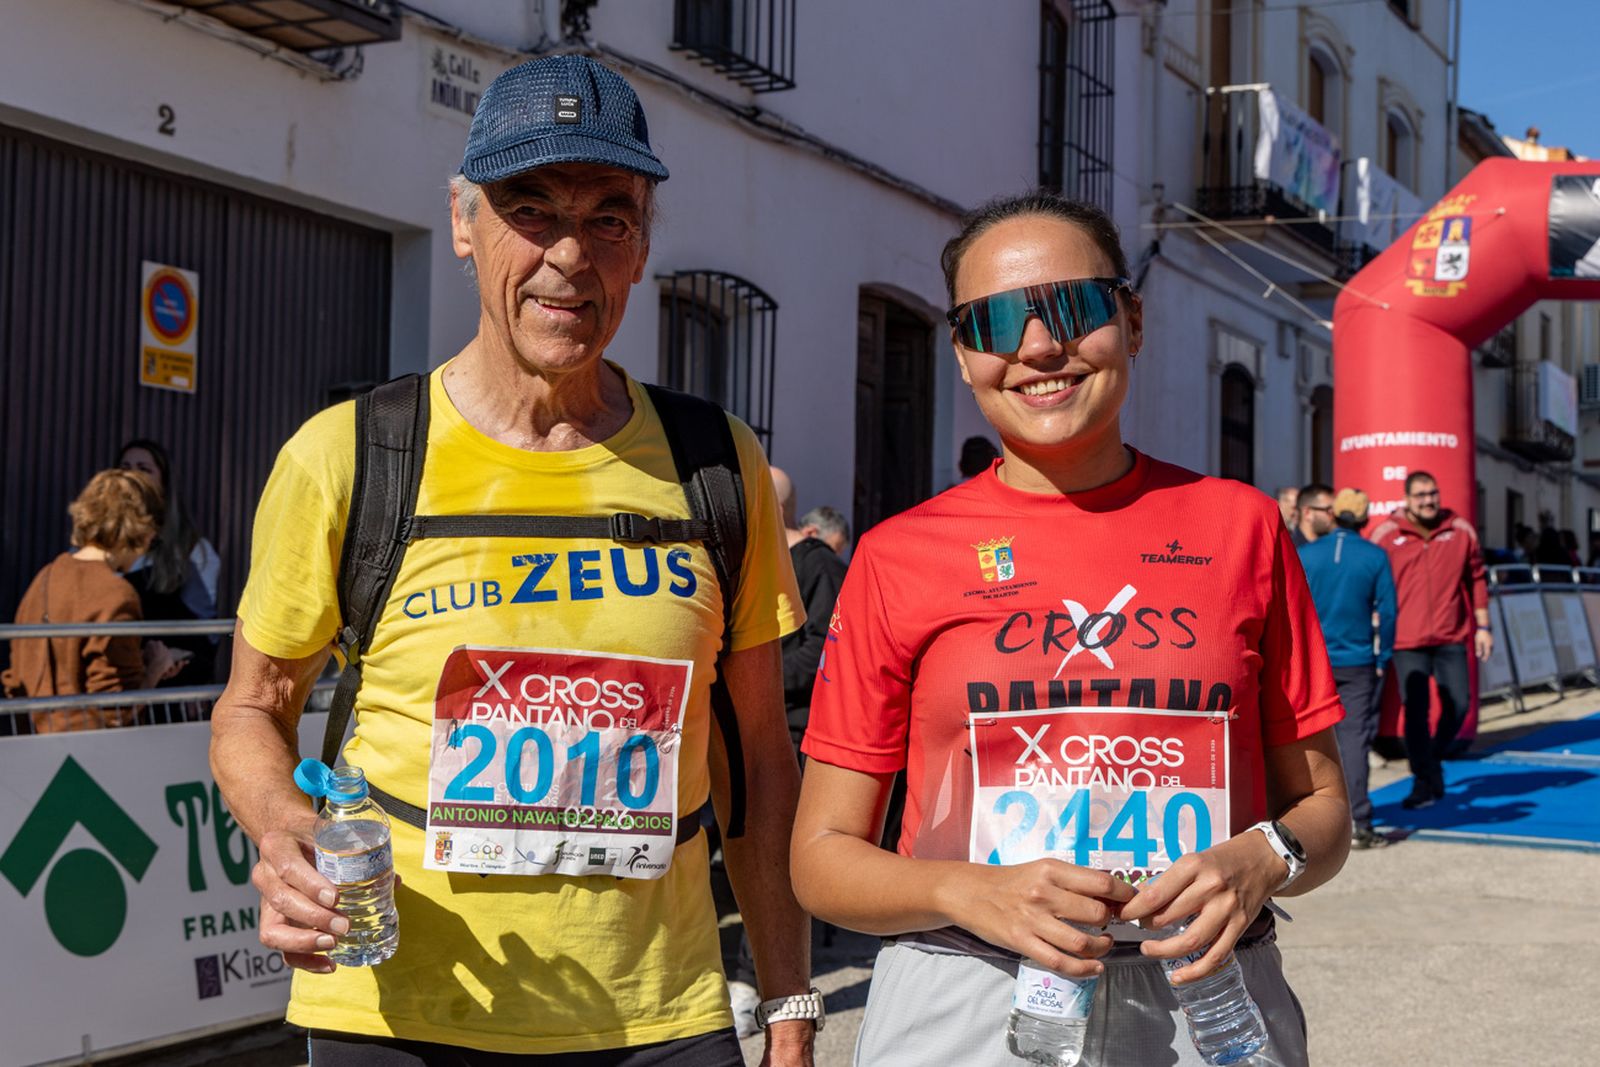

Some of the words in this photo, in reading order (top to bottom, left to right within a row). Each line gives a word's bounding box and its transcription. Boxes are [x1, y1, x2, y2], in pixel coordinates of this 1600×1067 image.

[157, 104, 176, 136] 2
[1340, 431, 1458, 452] AYUNTAMIENTO
[1382, 466, 1407, 480] DE
[1140, 552, 1213, 566] TEAMERGY
[402, 581, 503, 619] CLUB
[510, 547, 698, 605] ZEUS
[994, 607, 1198, 655] CROSS
[473, 660, 516, 699] X
[519, 674, 645, 710] CROSS
[472, 702, 615, 731] PANTANO
[619, 717, 641, 731] DEL
[1012, 724, 1053, 765] X
[1060, 735, 1185, 767] CROSS
[444, 724, 660, 809] 2010
[1014, 766, 1156, 793] PANTANO
[1161, 775, 1186, 789] DEL
[431, 806, 508, 825] ANTONIO
[512, 810, 591, 829] NAVARRO
[595, 813, 672, 830] PALACIOS
[987, 788, 1212, 868] 2440
[183, 907, 260, 941] FRAN
[1035, 990, 1057, 1000] AGUA
[1040, 999, 1064, 1009] ROSAL
